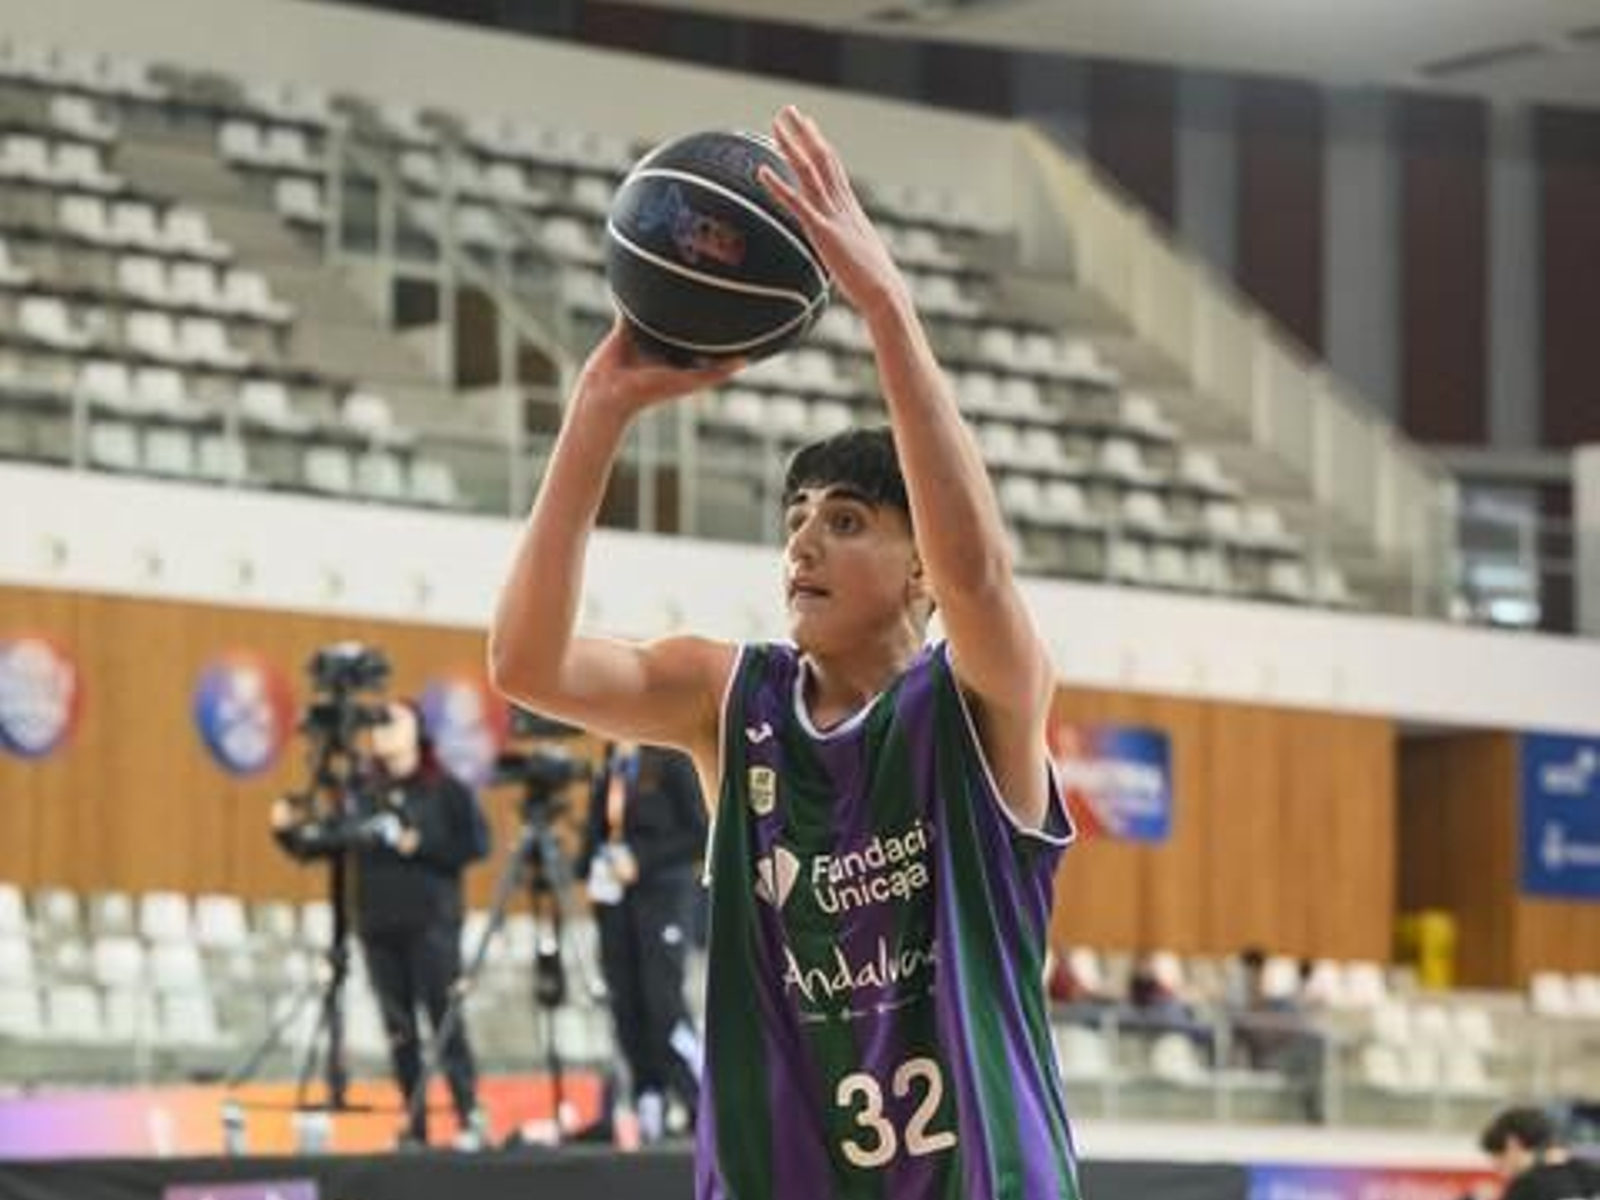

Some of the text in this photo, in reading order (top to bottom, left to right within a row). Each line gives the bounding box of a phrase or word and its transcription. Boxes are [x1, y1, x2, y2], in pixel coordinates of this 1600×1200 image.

[812, 818, 929, 883] Fundaci
[815, 861, 929, 913] Unicaja
[837, 1058, 956, 1168] 32
